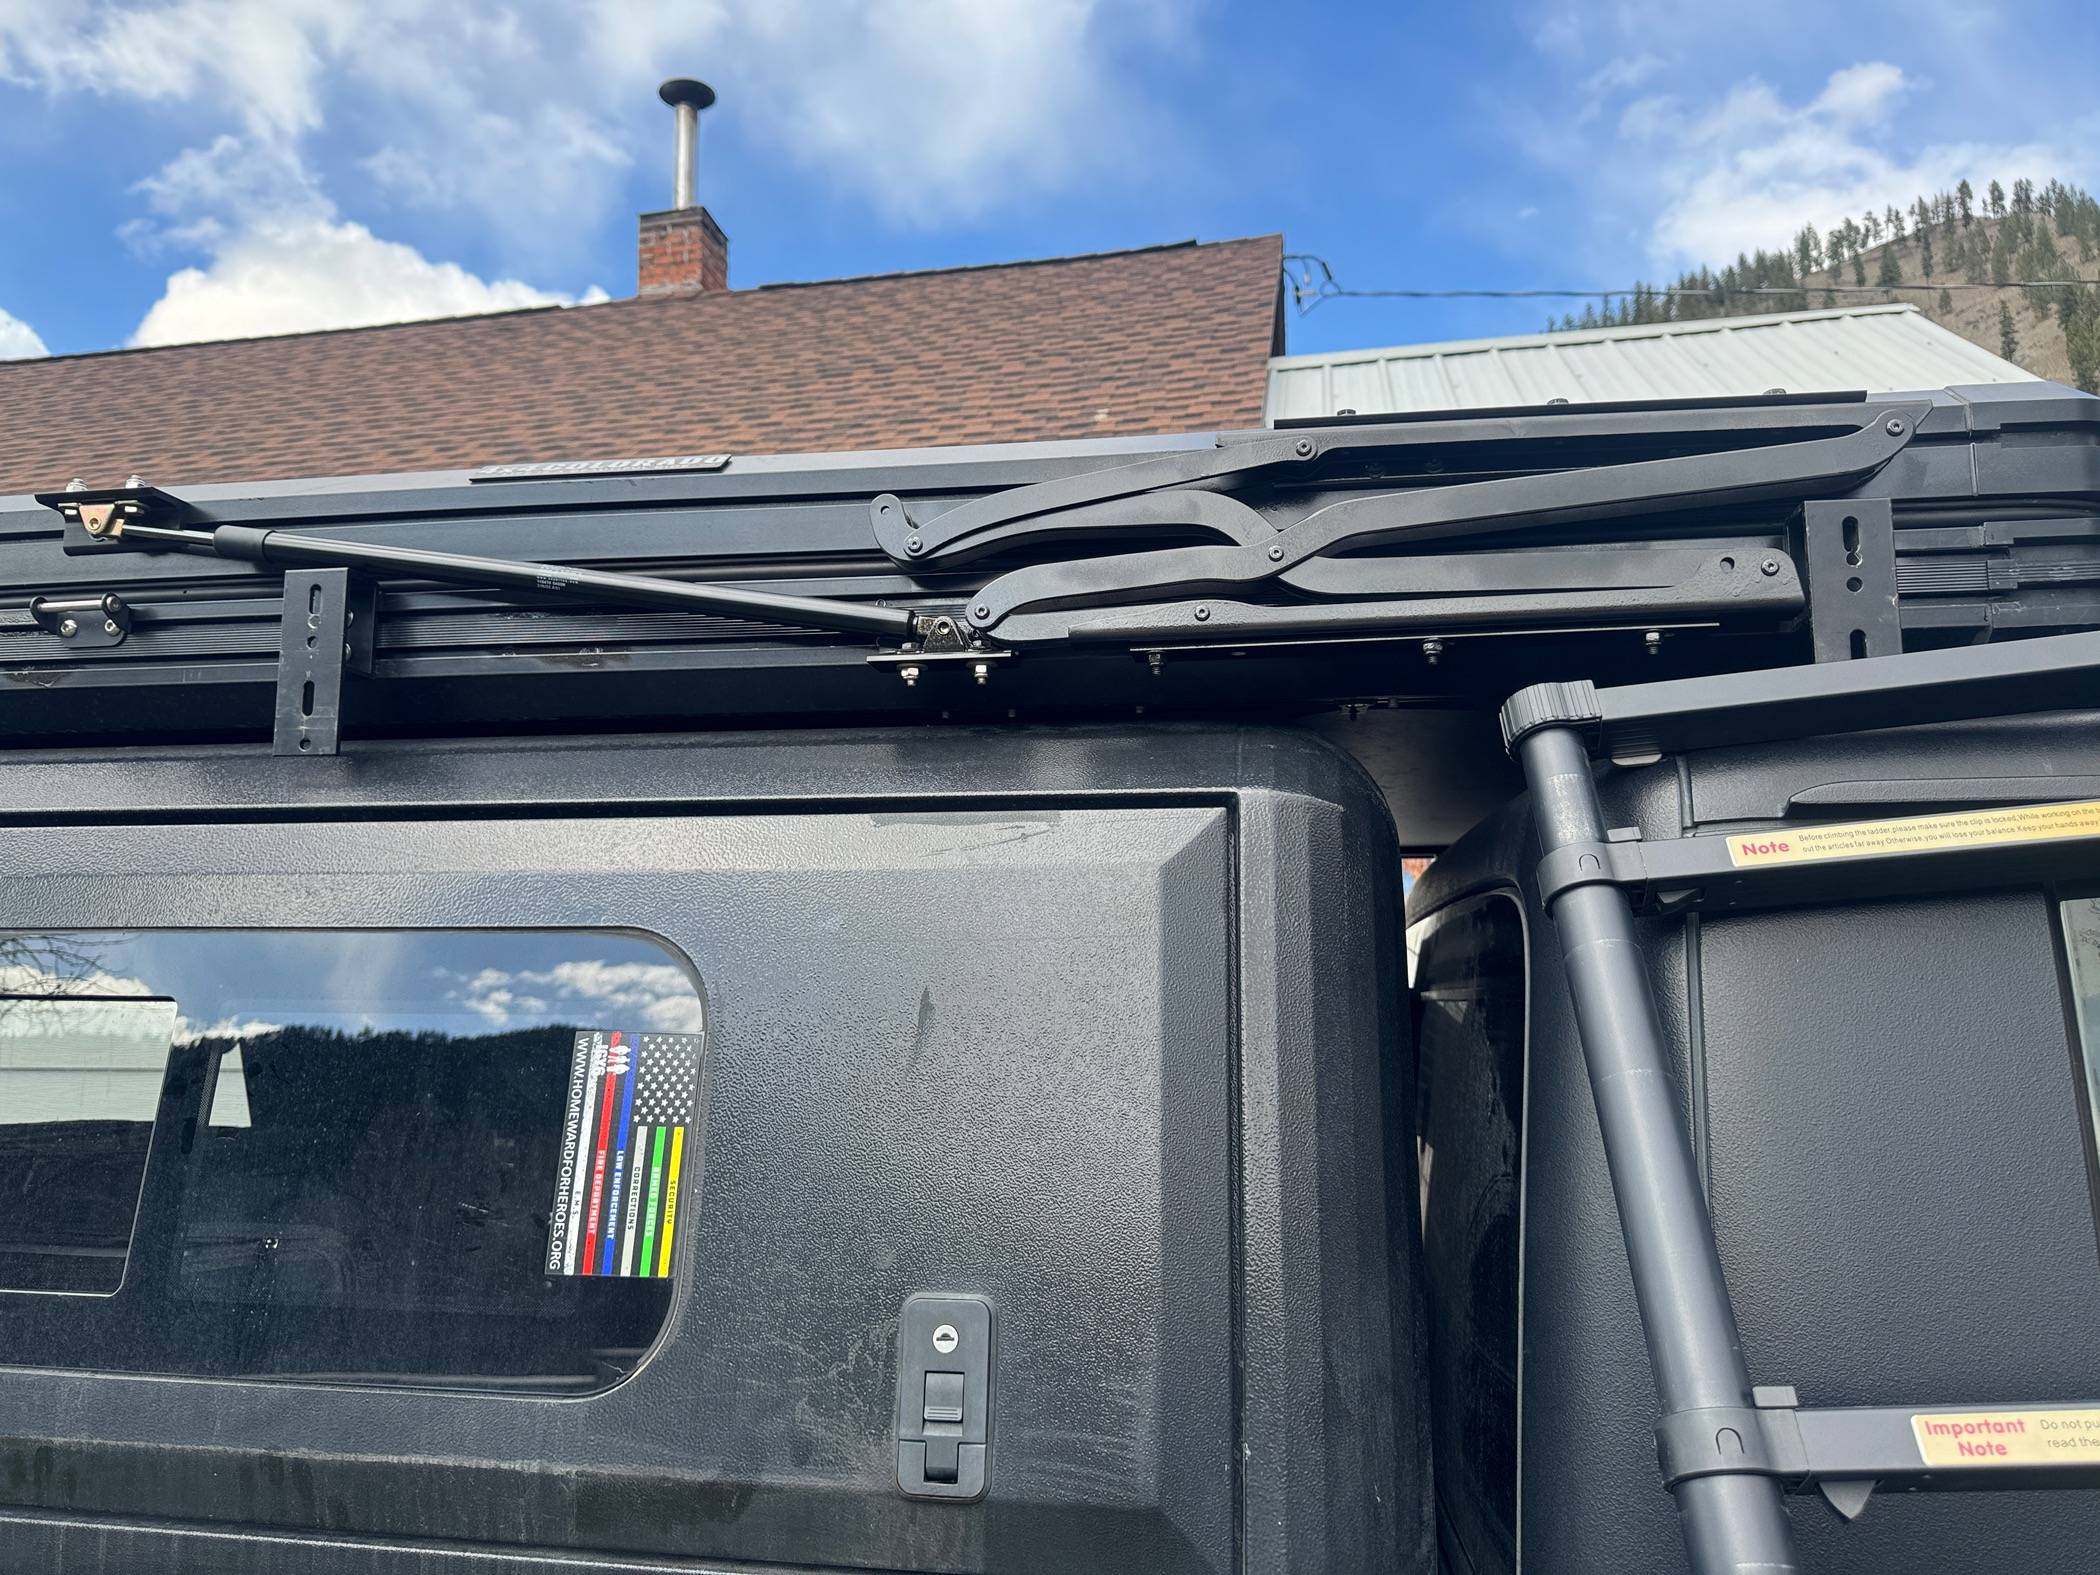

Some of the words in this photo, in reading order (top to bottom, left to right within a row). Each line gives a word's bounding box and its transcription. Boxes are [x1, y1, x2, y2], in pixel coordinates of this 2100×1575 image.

[1799, 834, 1823, 842] Before
[1824, 831, 1854, 839] climbing
[1855, 828, 1867, 836] the
[1917, 823, 1938, 831] make
[2042, 810, 2071, 819] working
[1828, 842, 1855, 850] articles
[1939, 832, 1952, 840] will
[1952, 830, 1968, 838] lose
[1969, 829, 1985, 838] your
[2038, 823, 2054, 831] your
[1741, 839, 1790, 856] Note
[548, 1037, 590, 1270] WWW.HOMEWARDFORHEROES.ORG
[596, 1150, 606, 1171] FIRE
[615, 1150, 625, 1169] LAW
[650, 1166, 661, 1199] ARMED
[571, 1190, 581, 1220] E.M.S.
[588, 1173, 603, 1235] DEPARTMENT
[607, 1172, 622, 1240] ENFORCEMENT
[627, 1166, 641, 1231] CORRECTIONS
[666, 1180, 676, 1225] SECURITY
[646, 1201, 658, 1238] FORCES
[1924, 1418, 2026, 1438] Important
[2040, 1419, 2057, 1430] Do
[2061, 1419, 2083, 1430] not
[1957, 1441, 2008, 1457] Note
[2047, 1437, 2077, 1448] read
[2079, 1436, 2100, 1447] the
